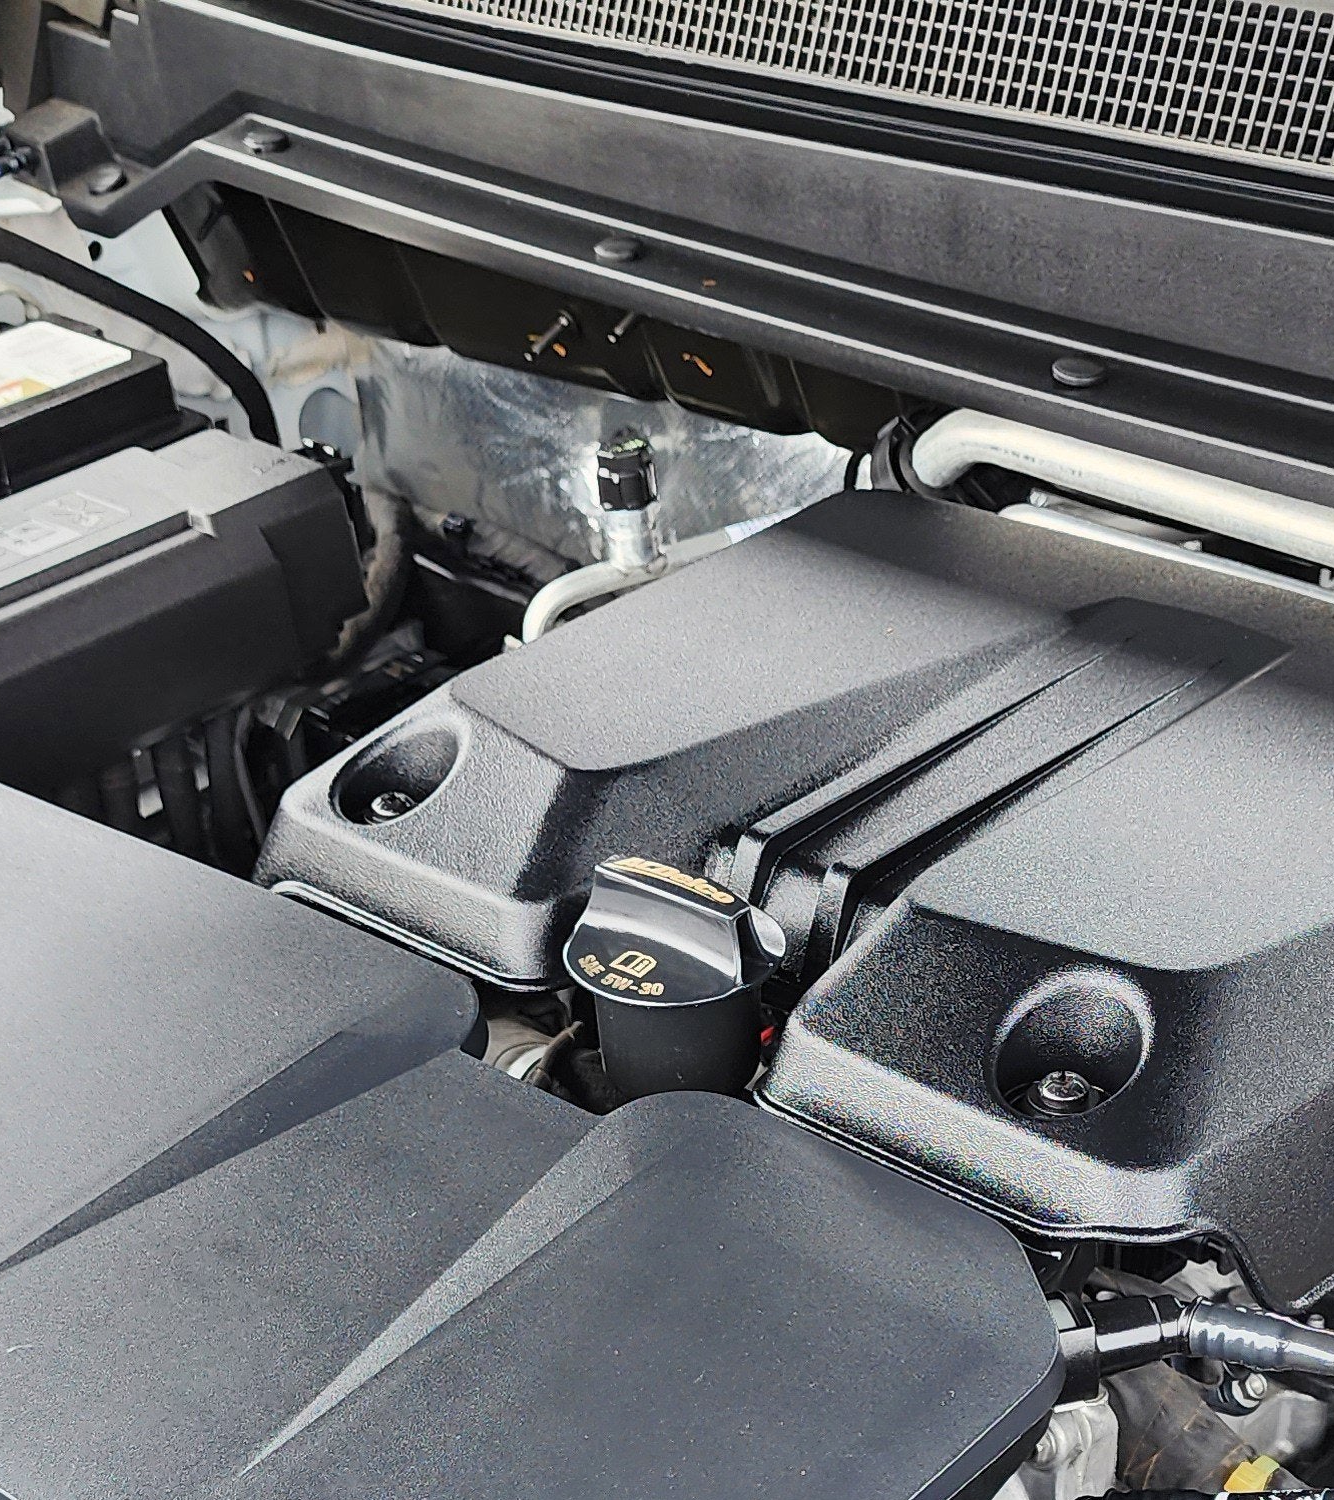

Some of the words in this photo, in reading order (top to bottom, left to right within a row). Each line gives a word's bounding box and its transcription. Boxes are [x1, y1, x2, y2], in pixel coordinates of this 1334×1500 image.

[611, 856, 735, 904] ACDelco
[578, 954, 606, 978] SAE
[600, 972, 665, 996] 5W-30
